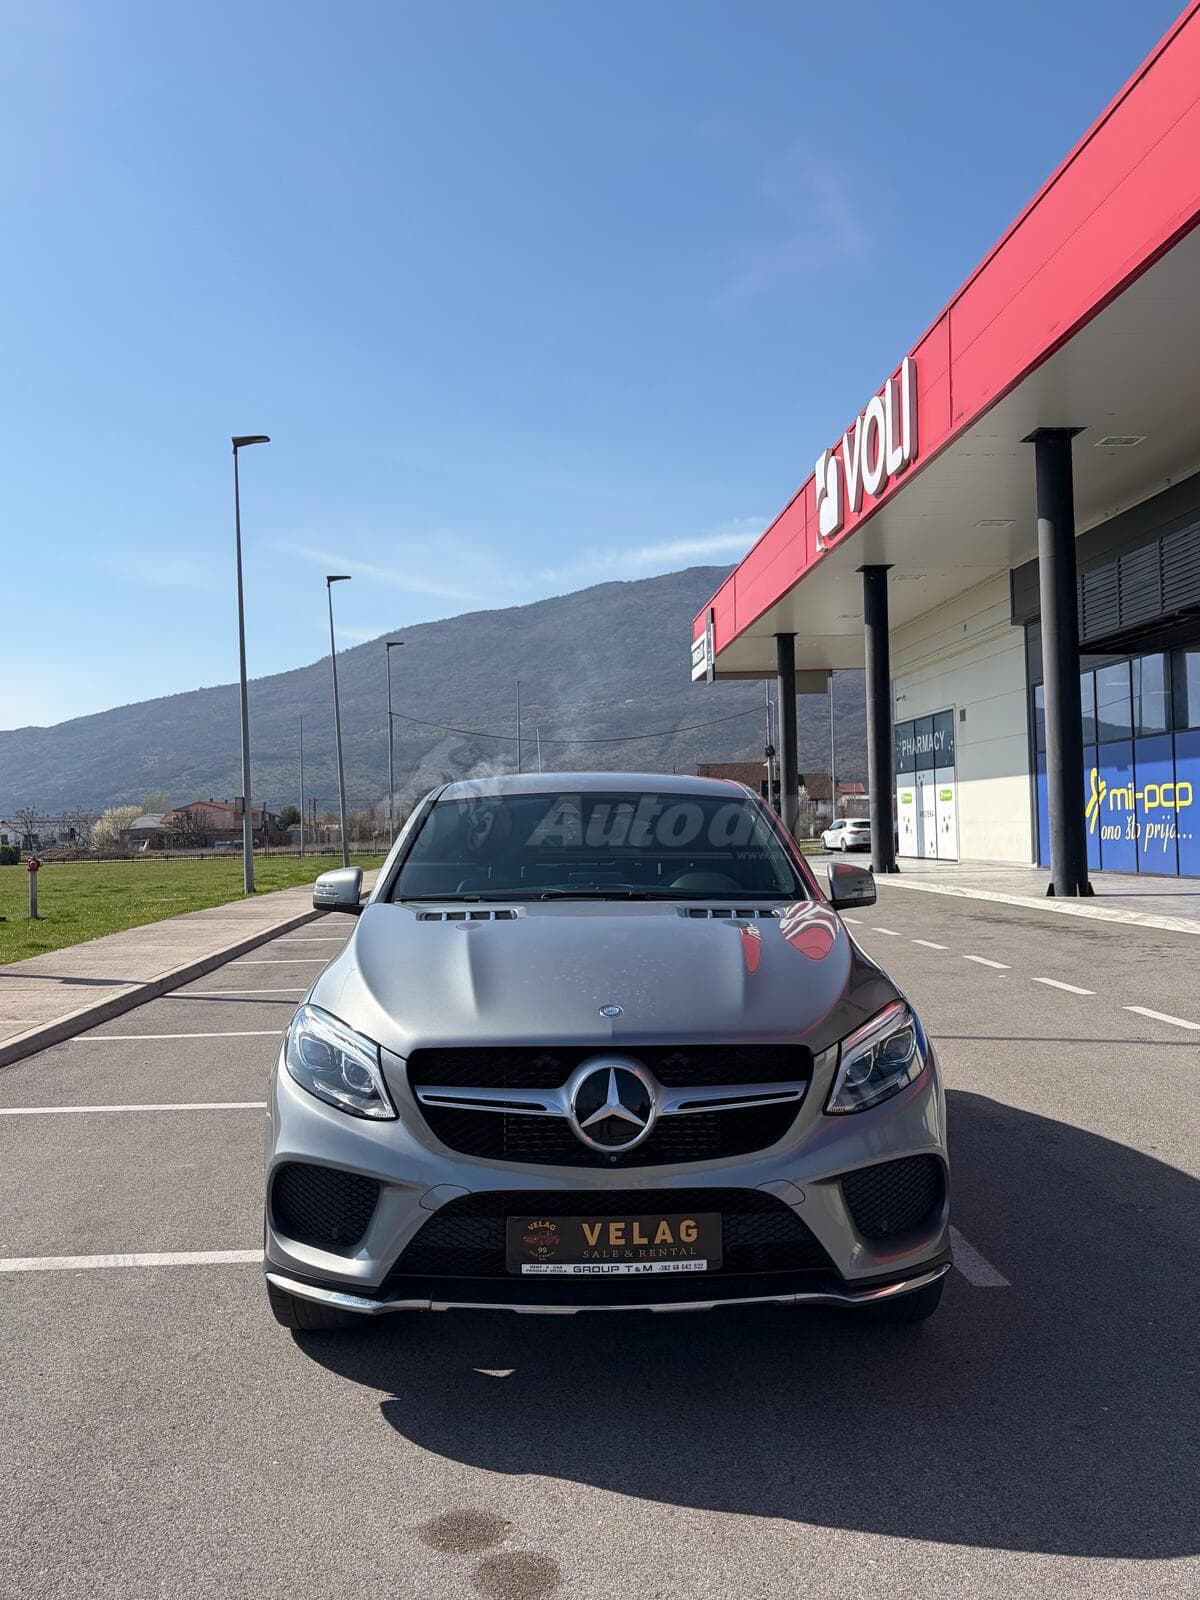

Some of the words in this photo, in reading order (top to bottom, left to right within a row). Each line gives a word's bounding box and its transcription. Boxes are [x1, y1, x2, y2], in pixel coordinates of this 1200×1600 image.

[843, 357, 917, 513] VOLI
[902, 731, 944, 757] PHARMACY
[1101, 825, 1121, 841] ono
[528, 1221, 557, 1231] VELAG
[581, 1219, 698, 1246] VELAG
[582, 1249, 620, 1259] SALE
[624, 1249, 633, 1258] &
[640, 1247, 697, 1258] RENTAL
[573, 1265, 620, 1273] GROUP
